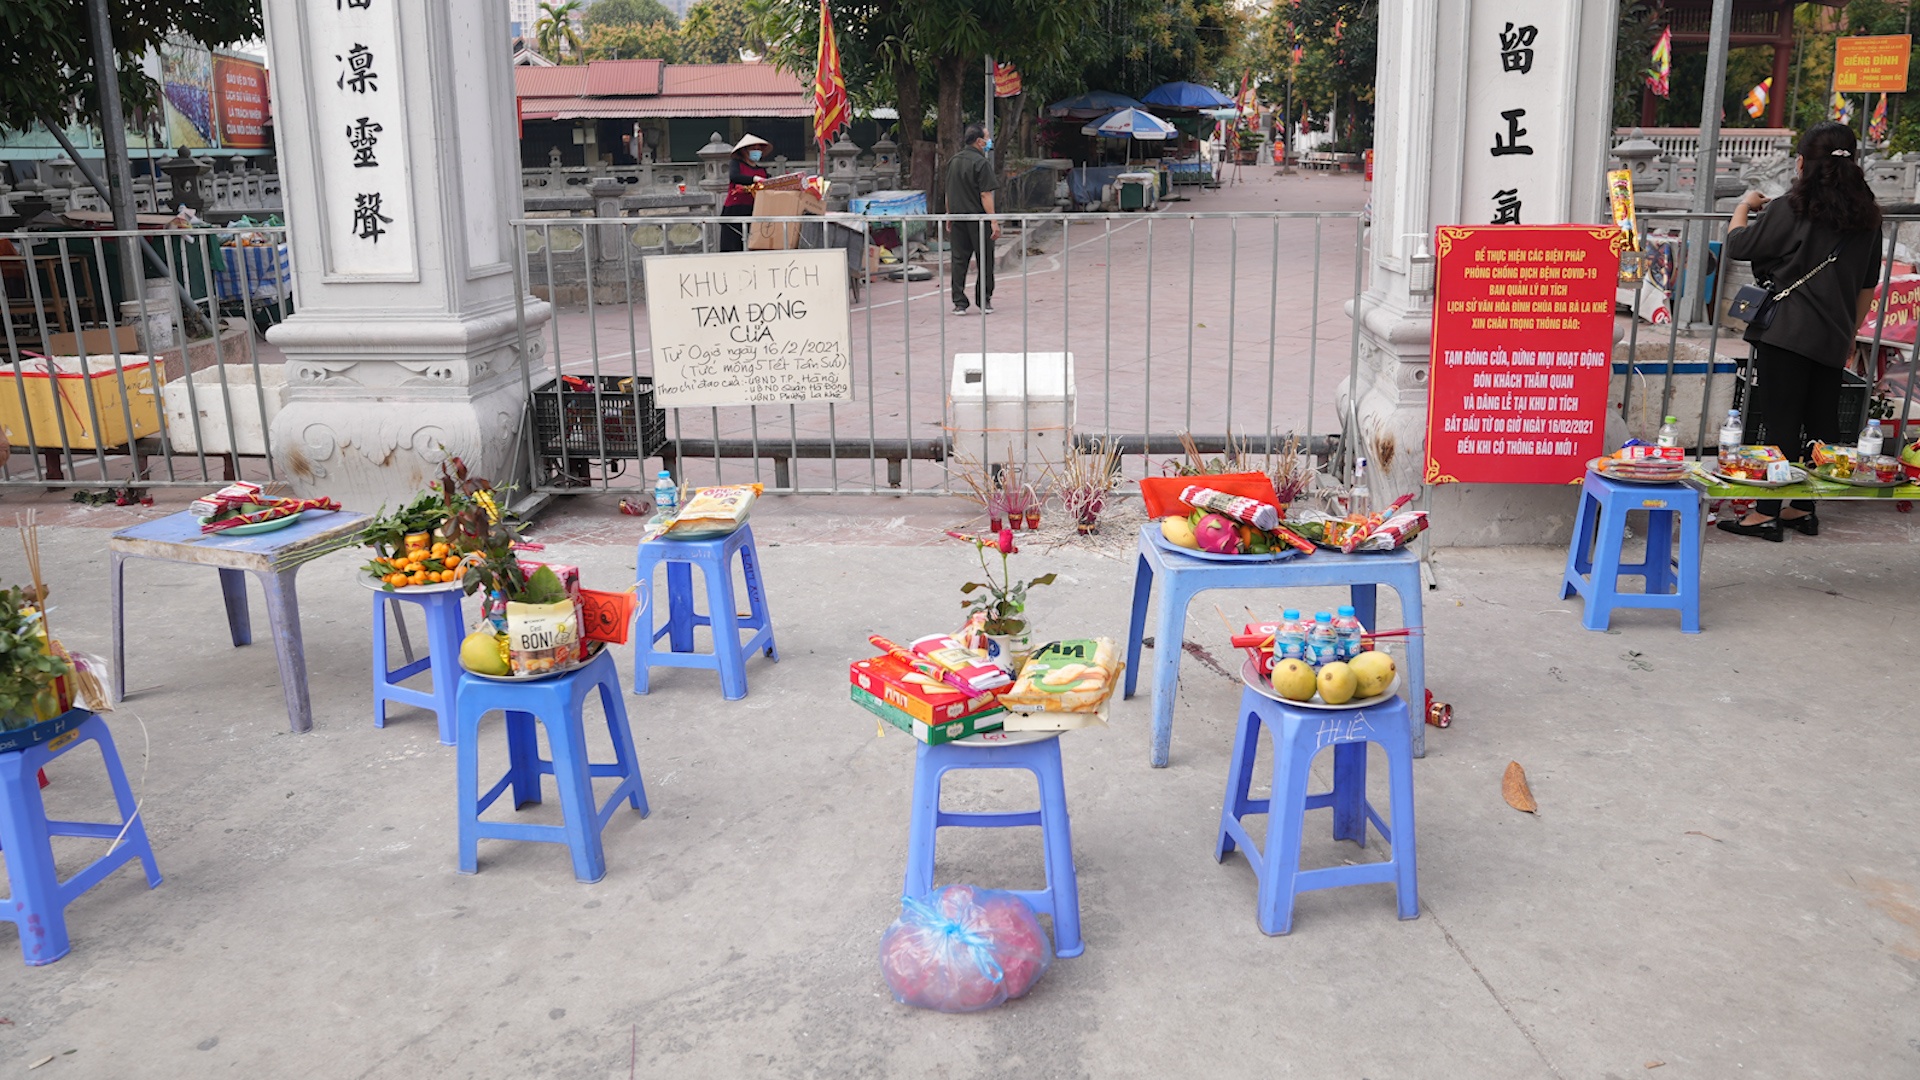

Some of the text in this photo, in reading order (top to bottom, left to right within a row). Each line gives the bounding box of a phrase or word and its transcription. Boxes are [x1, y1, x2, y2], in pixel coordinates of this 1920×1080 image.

[1843, 54, 1898, 66] GIẾNG ĐÌNH
[1838, 69, 1857, 85] CẤM
[1475, 246, 1586, 264] ĐỂ THỰC HIỆN CÁC BIỆN PHÁP
[679, 271, 728, 299] KHU
[768, 260, 820, 288] TÍCH
[1464, 263, 1597, 281] PHÒNG CHỐNG DỊCH BỆNH COVID-19
[1489, 280, 1568, 297] BAN QUẢN LÝ DI TÍCH
[692, 293, 807, 328] TẠM ĐÓNG
[1447, 297, 1608, 314] LỊCH SỬ VĂN HÓA ĐÌNH CHÙA BIA BÀ LA KHÊ
[730, 321, 774, 343] CỬA
[1472, 316, 1580, 331] XIN CHÂN TRỌNG THÔNG BÁO:
[727, 345, 757, 363] ngày
[1445, 345, 1604, 369] TẠM ĐÓNG CỬA, DỪNG MỌI HOẠT ĐỘNG
[1474, 371, 1574, 390] ĐÓN KHÁCH THĂM QUAN
[1464, 391, 1578, 413] VÀ DÂNG LỄ TẠI KHU DI TÍCH
[1445, 413, 1593, 434] BẮT ĐẦU TỪ 00 GIỜ NGÀY 16/02/2021
[1458, 436, 1475, 454] ĐẾN
[1476, 440, 1491, 454] KHI
[1493, 438, 1504, 454] CÓ
[1506, 438, 1535, 455] THÔNG
[1536, 438, 1554, 455] BÁO
[1555, 438, 1572, 456] MỚI
[522, 632, 553, 650] BON!
